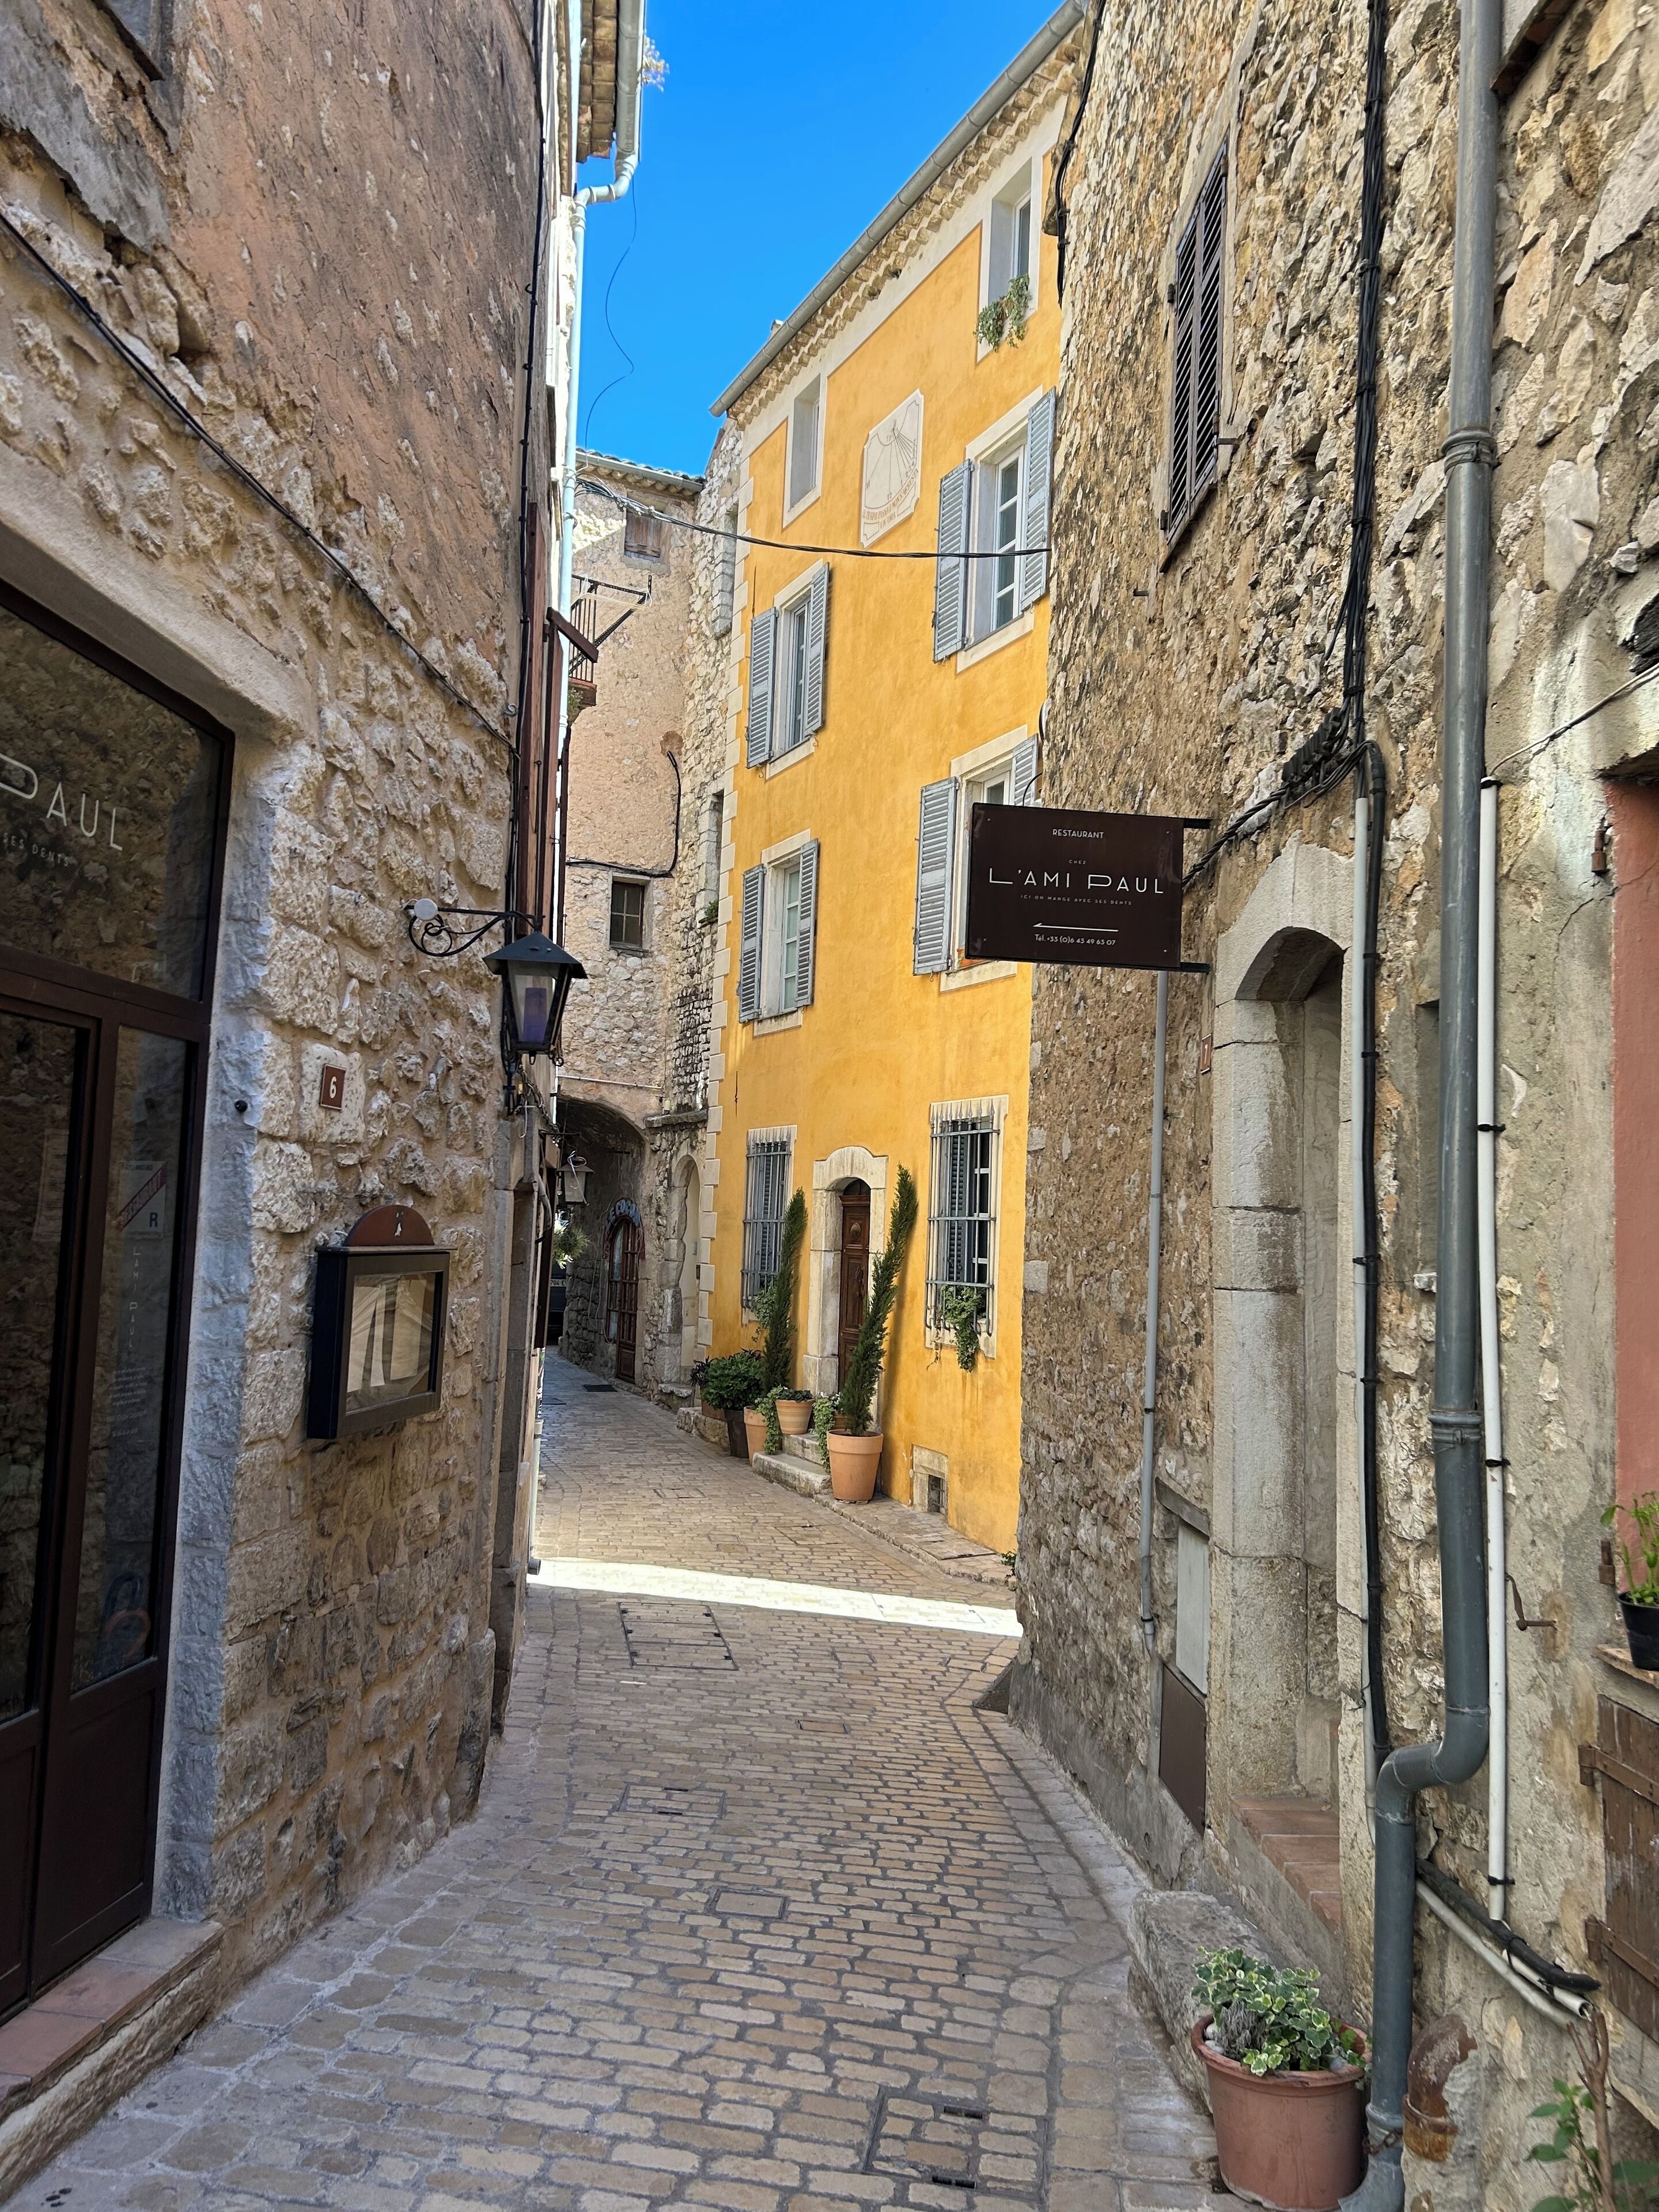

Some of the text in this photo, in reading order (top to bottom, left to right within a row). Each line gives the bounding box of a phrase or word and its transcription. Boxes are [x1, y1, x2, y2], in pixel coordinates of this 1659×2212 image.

[1052, 828, 1104, 839] RESTAURANT
[2, 832, 69, 868] SES DENTS
[989, 868, 1164, 893] L'AMI PAUL
[329, 1076, 337, 1099] 6
[150, 1212, 158, 1228] R
